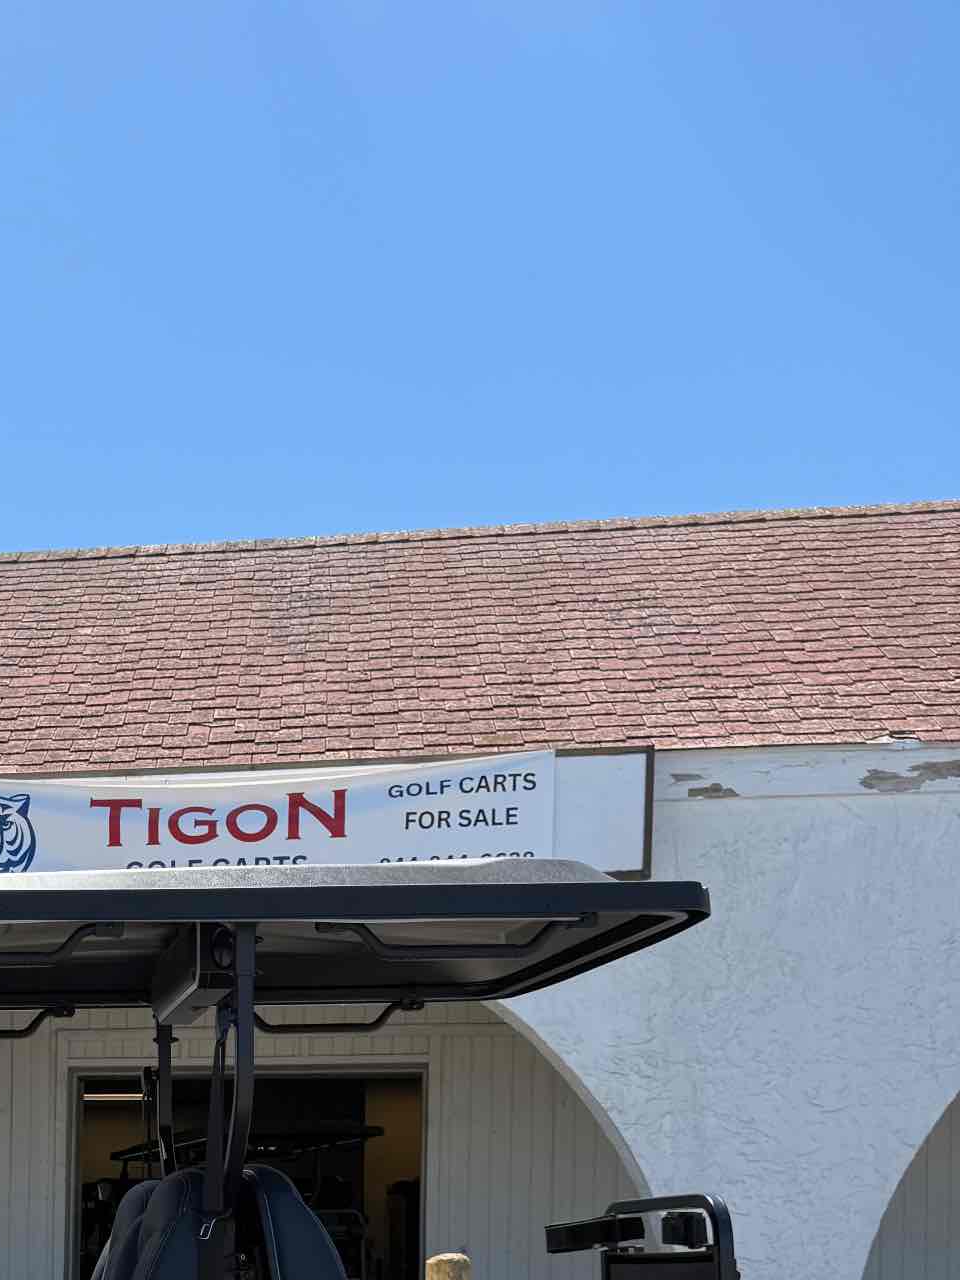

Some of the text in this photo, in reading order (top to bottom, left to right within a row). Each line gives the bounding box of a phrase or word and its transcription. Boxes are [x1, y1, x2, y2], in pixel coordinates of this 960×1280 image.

[388, 773, 537, 798] GOLF CARTS
[90, 789, 348, 847] TIGON
[404, 807, 519, 830] FOR SALE
